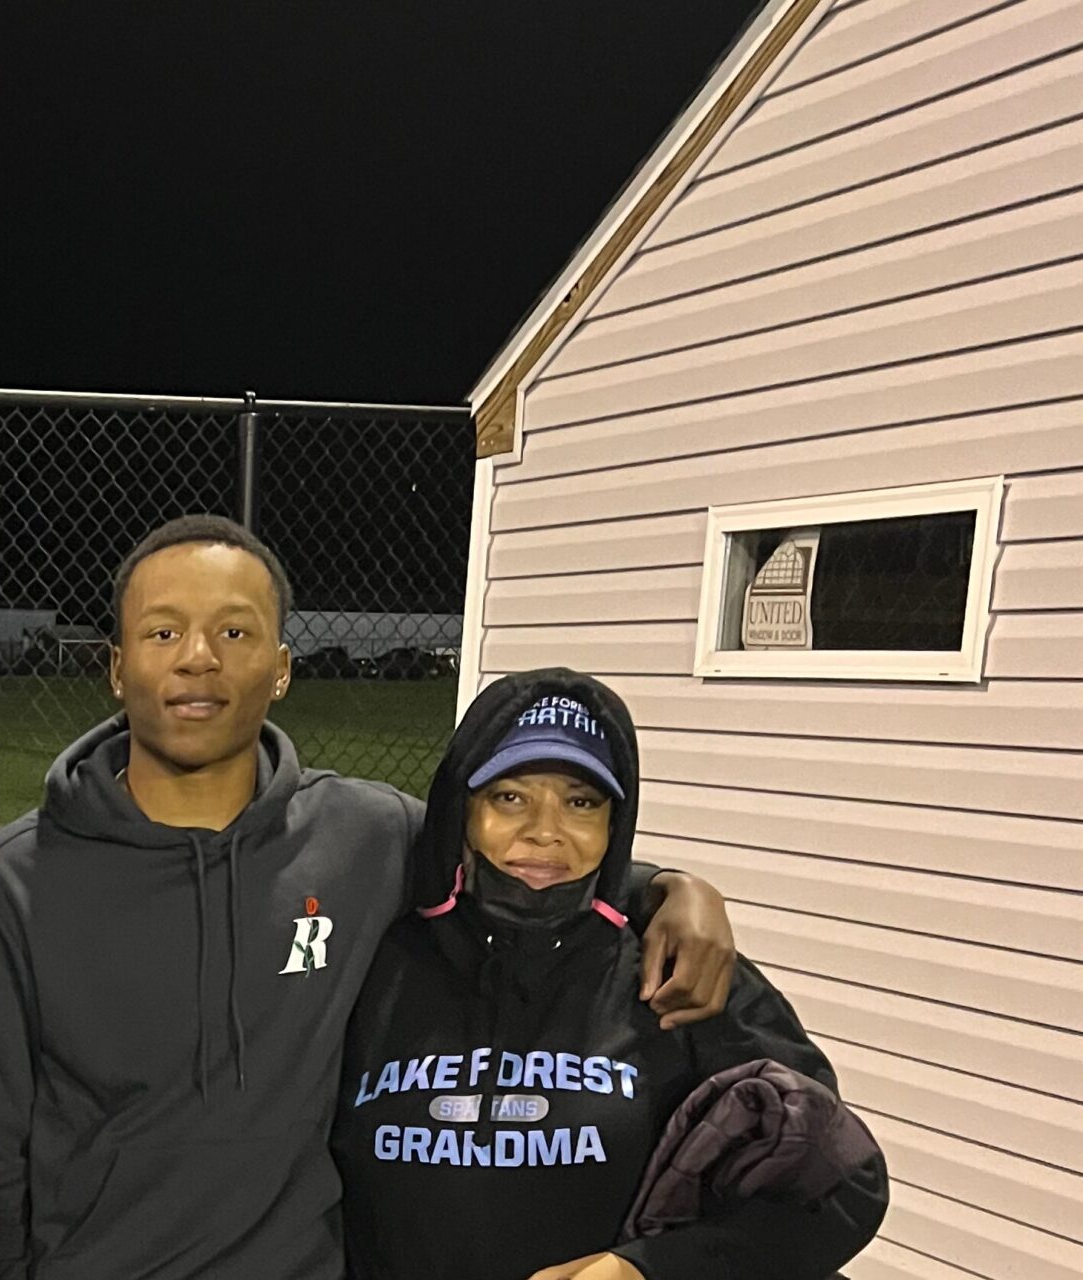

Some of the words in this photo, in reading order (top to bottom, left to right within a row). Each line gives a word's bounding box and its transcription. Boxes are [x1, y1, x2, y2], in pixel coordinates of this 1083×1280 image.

[749, 601, 802, 624] UNITED
[278, 916, 333, 974] R
[355, 1054, 464, 1108] LAKE
[439, 1100, 538, 1118] SPATANS
[374, 1124, 607, 1168] GRANDMA
